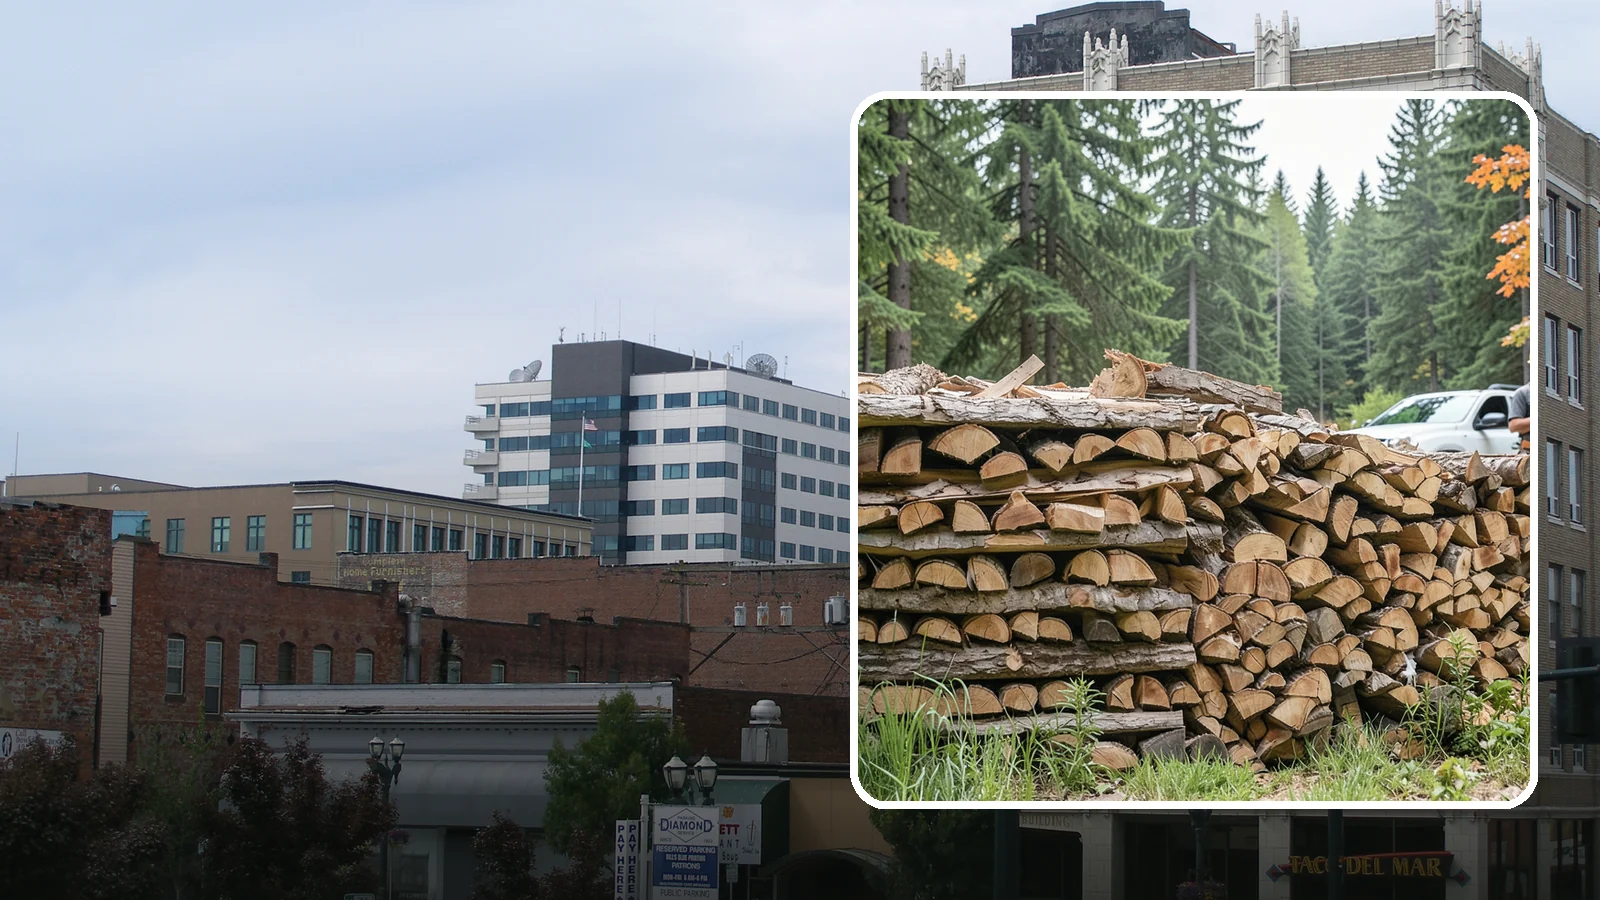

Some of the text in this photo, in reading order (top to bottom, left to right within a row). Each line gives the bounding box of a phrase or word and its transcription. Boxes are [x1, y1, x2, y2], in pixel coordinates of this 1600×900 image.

[343, 566, 427, 577] Home Furnishers
[661, 818, 713, 833] DIAMOND
[1021, 815, 1070, 828] BUILDING
[656, 845, 716, 854] RESERVED PARKING
[616, 824, 625, 894] PAY HERE
[627, 824, 637, 894] PAY HERE
[721, 851, 739, 862] Soup
[671, 862, 701, 870] PATRONS
[1289, 855, 1442, 876] TAC DEL MAR
[660, 888, 710, 898] PUBLIC PARKING
